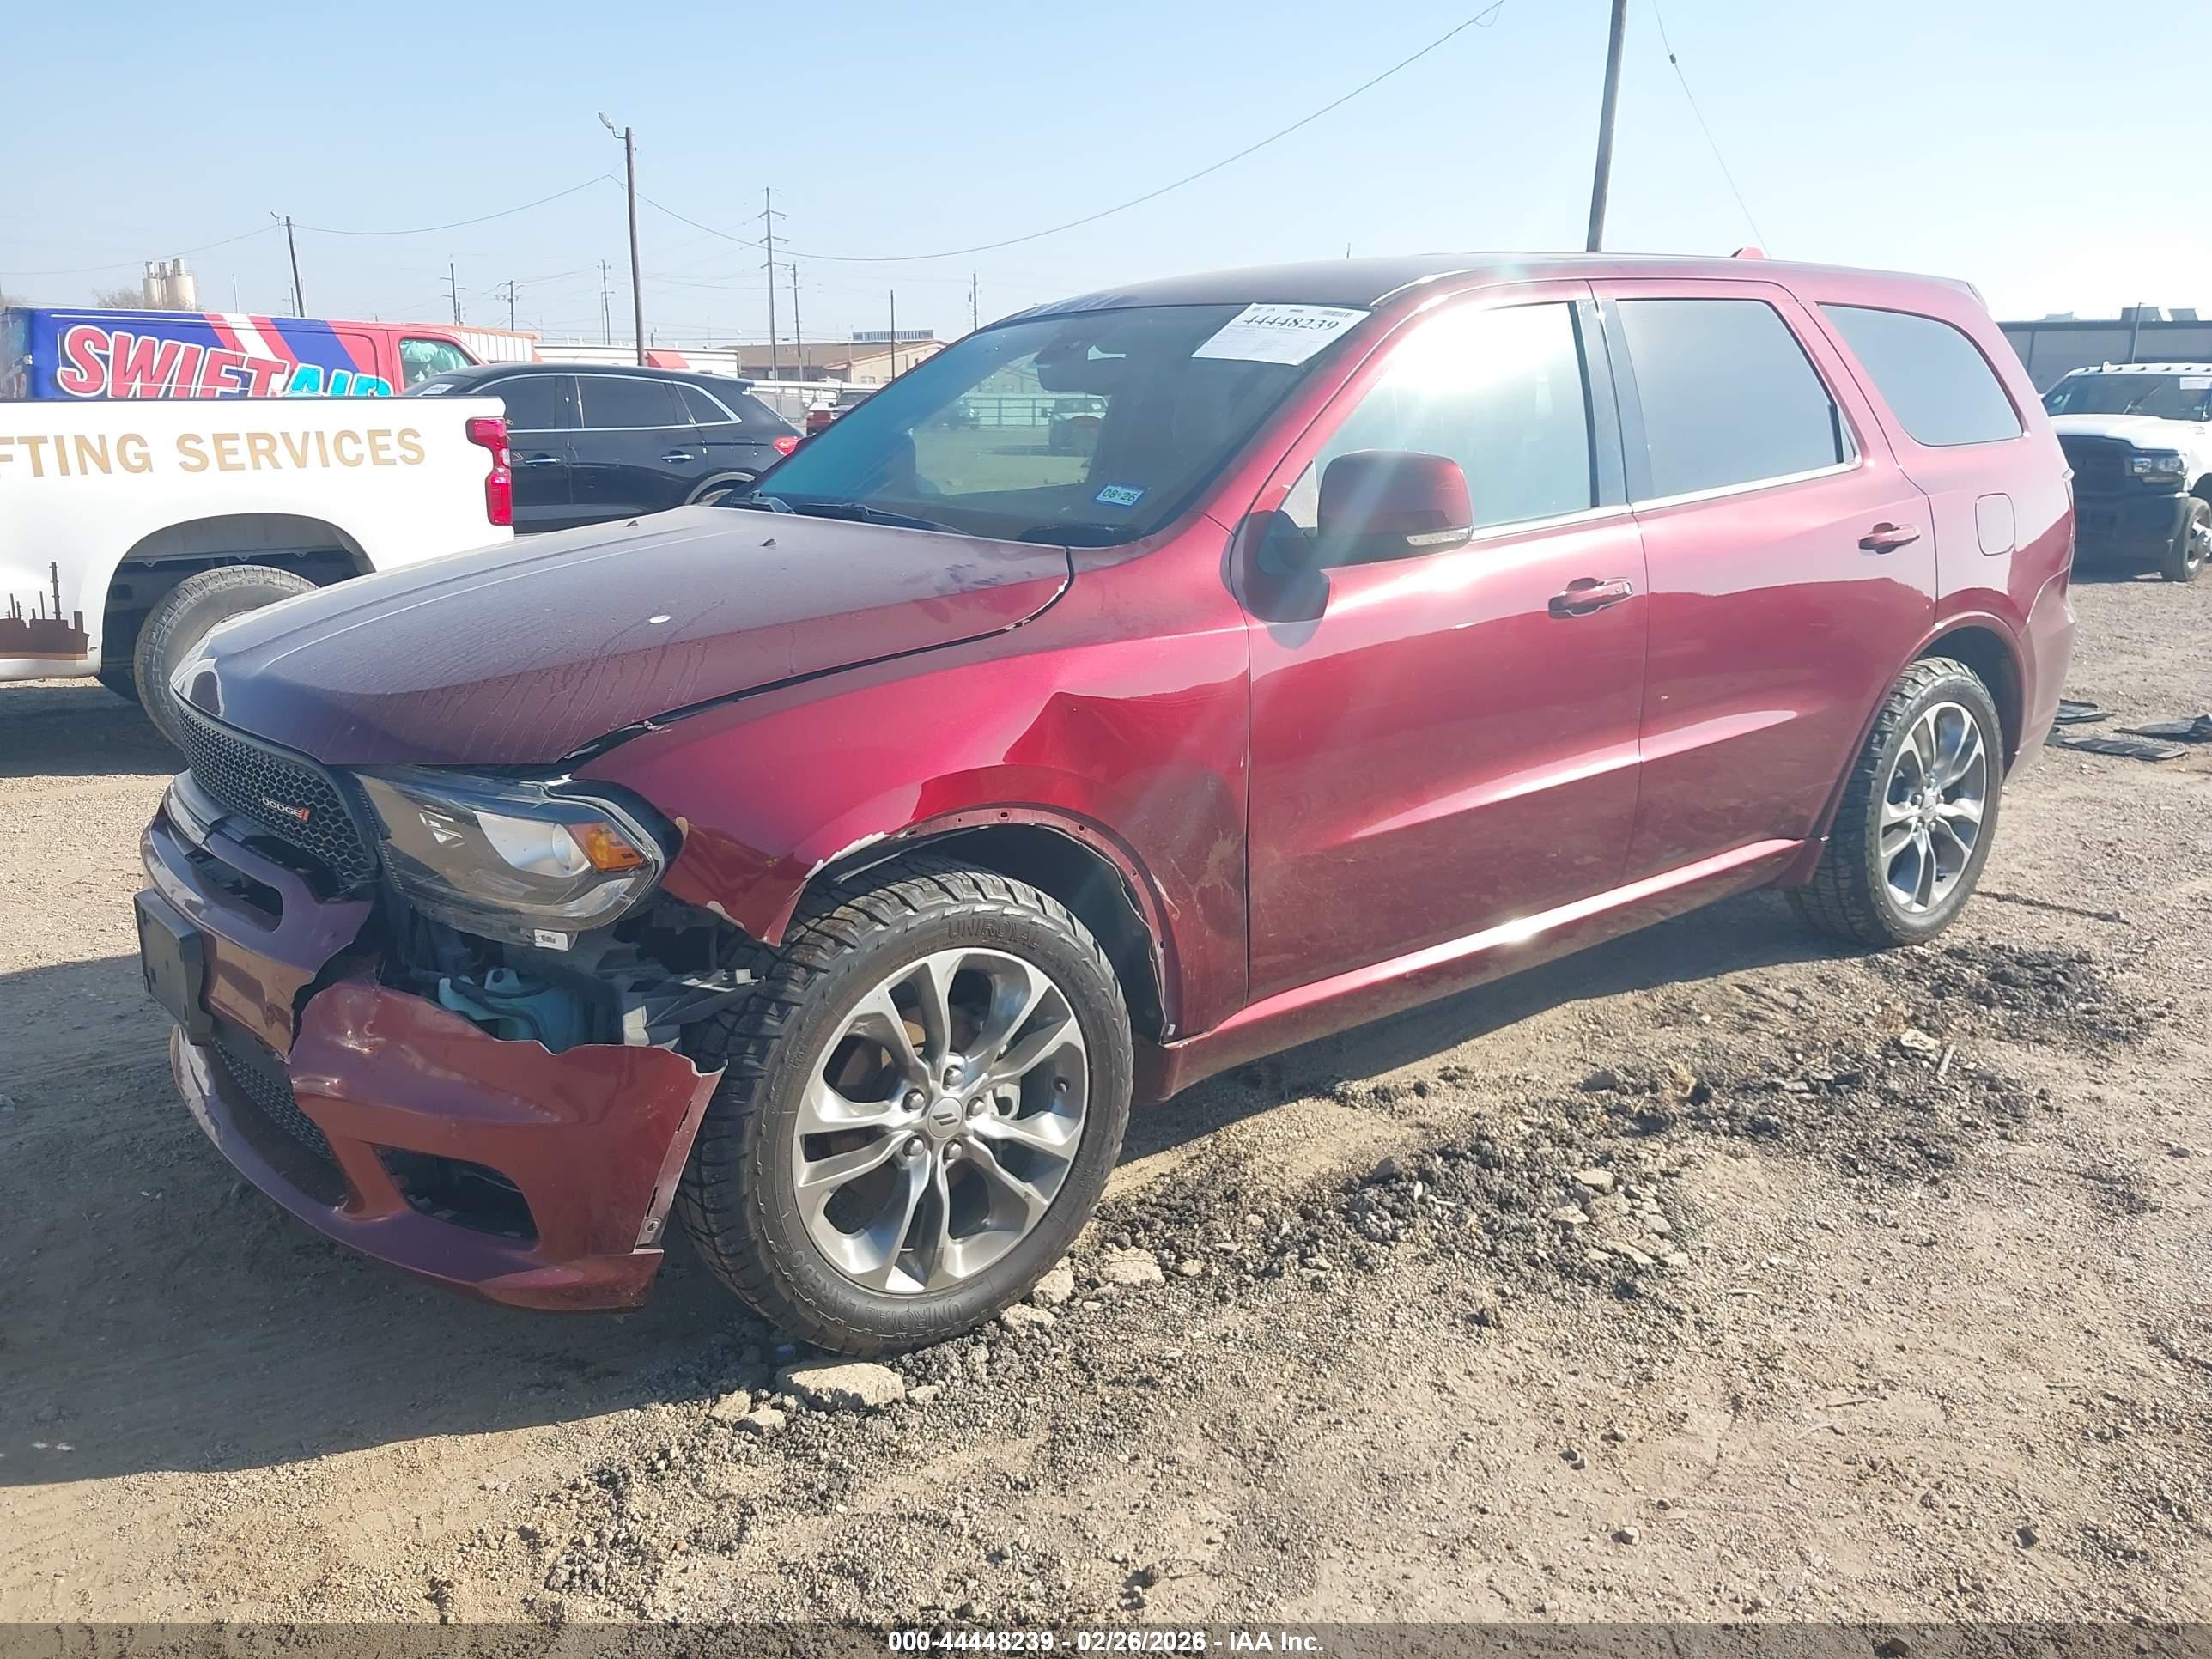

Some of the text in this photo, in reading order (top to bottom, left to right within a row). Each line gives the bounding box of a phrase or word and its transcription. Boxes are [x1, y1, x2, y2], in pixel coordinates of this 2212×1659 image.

[1243, 315, 1340, 331] 44448239
[57, 325, 289, 398] SWIFT
[176, 428, 426, 473] SERVICES
[262, 796, 303, 819] DODGE
